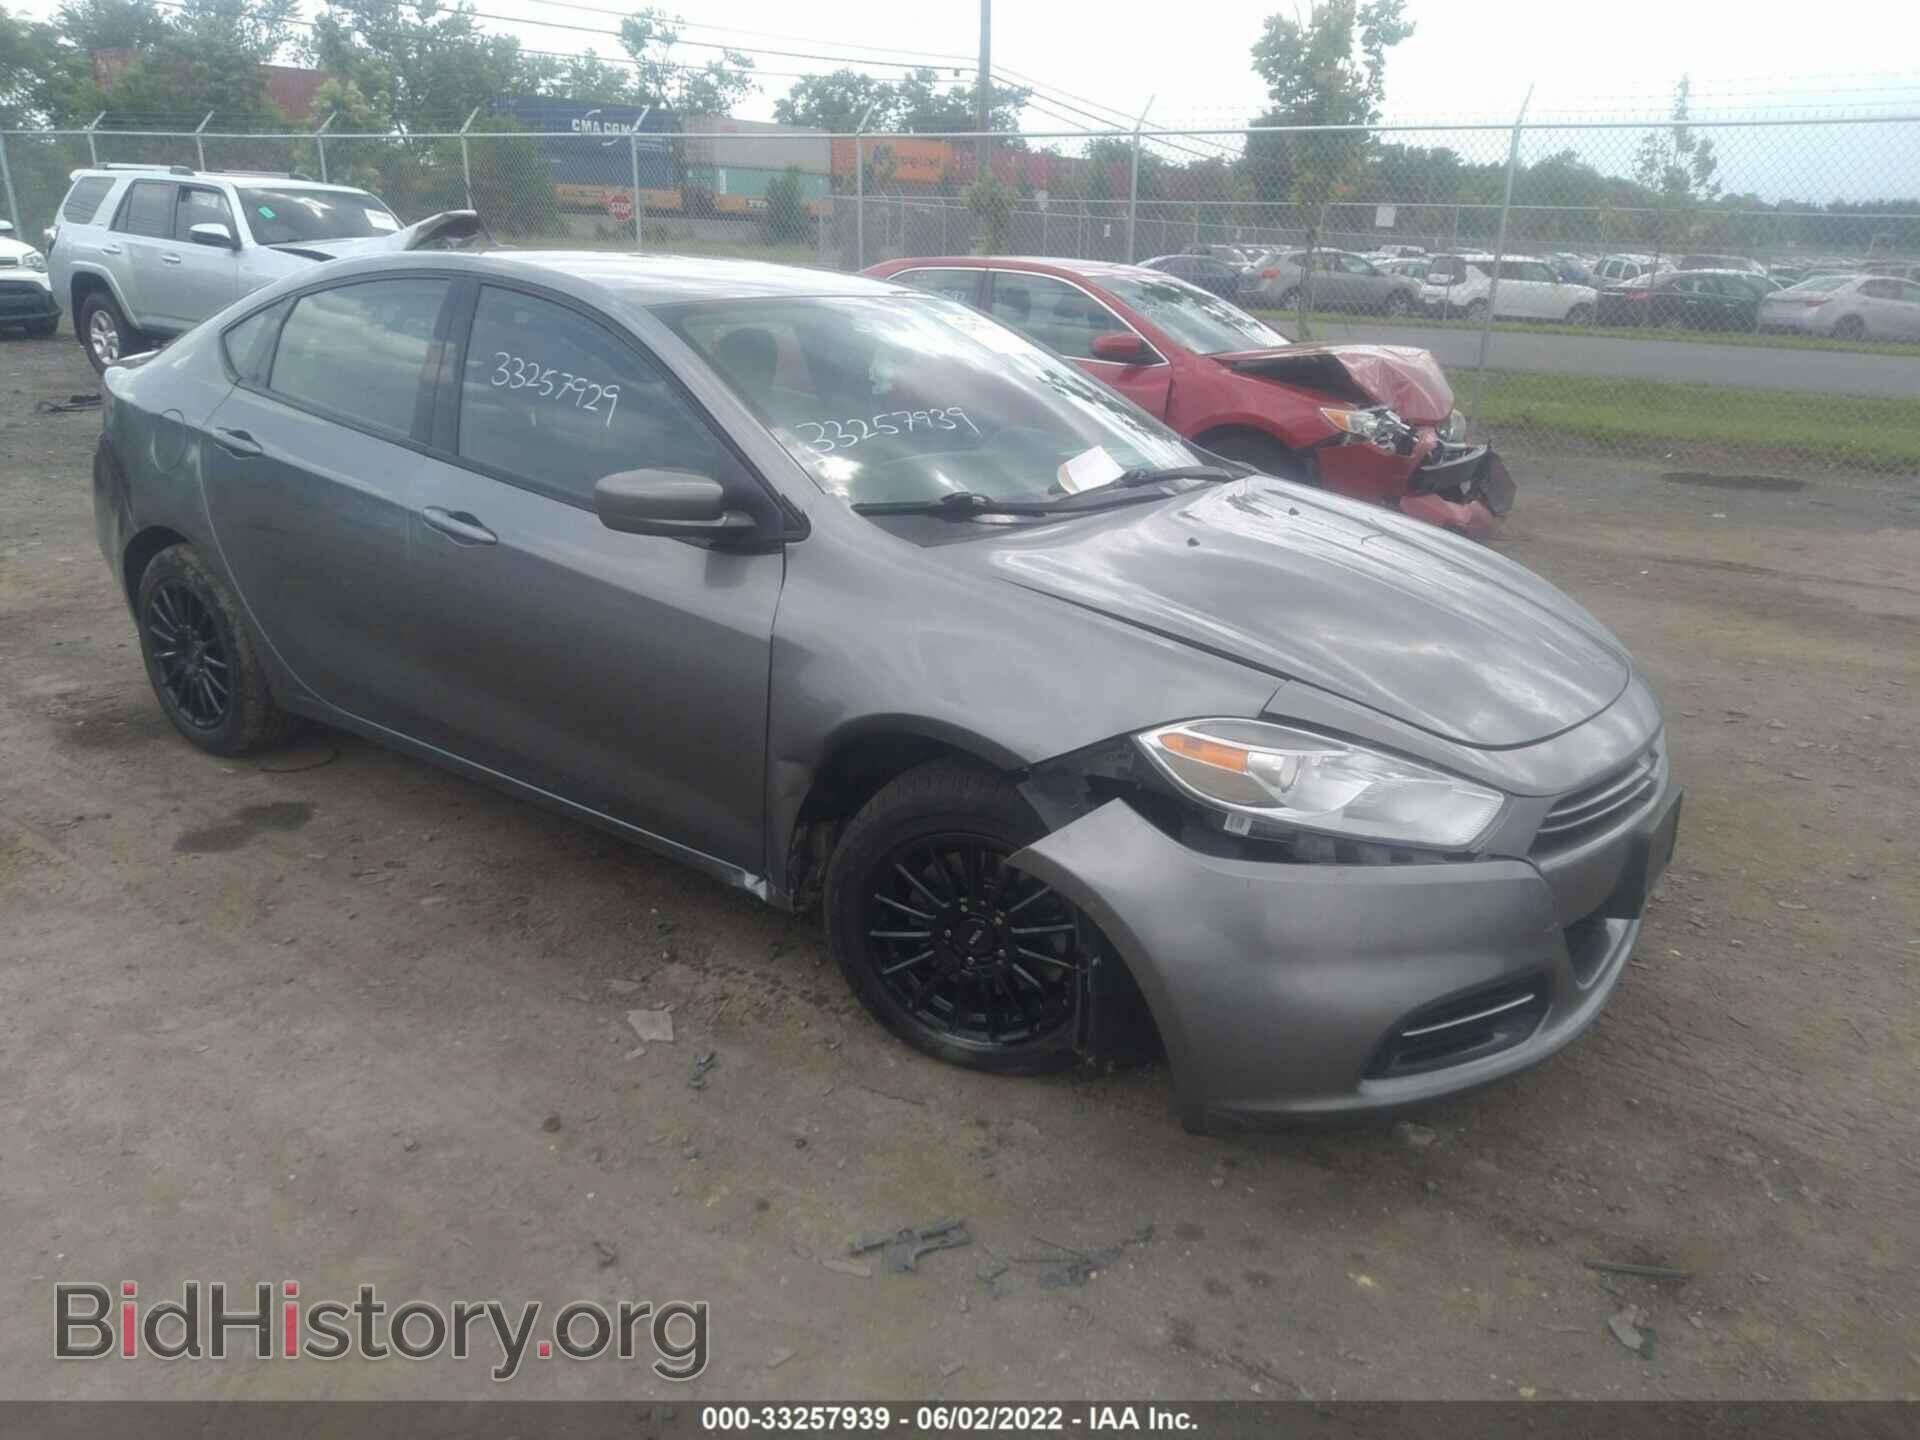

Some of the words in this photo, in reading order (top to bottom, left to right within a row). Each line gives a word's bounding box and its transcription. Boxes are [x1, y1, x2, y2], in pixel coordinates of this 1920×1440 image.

[572, 118, 600, 135] CMA
[609, 202, 632, 213] STOP
[491, 351, 621, 428] 33257929
[796, 407, 982, 452] 33257939
